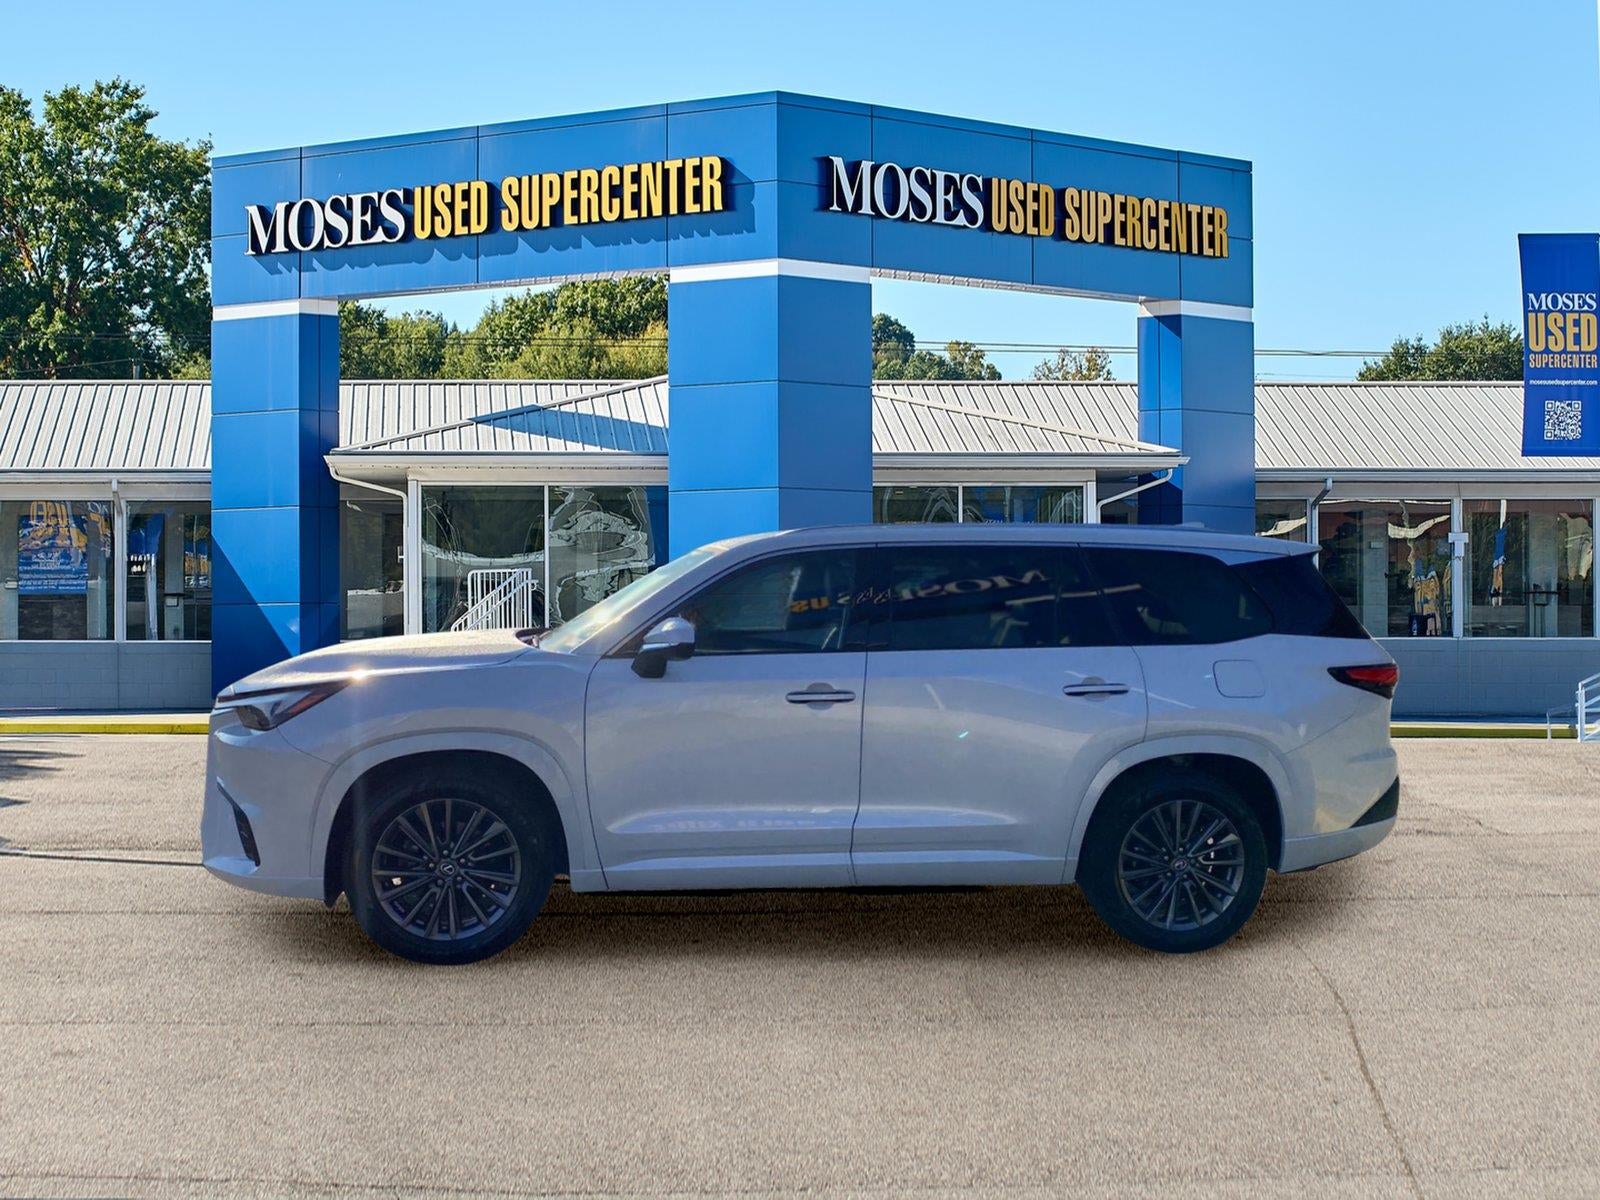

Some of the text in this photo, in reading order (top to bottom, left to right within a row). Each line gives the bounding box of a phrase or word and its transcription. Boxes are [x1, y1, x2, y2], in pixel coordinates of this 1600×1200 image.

[244, 155, 723, 256] MOSES USED SUPERCENTER
[828, 155, 1228, 258] MOSES USED SUPERCENTER
[1527, 292, 1597, 311] MOSES
[1528, 312, 1597, 352] USED
[1529, 353, 1598, 369] SUPERCENTER
